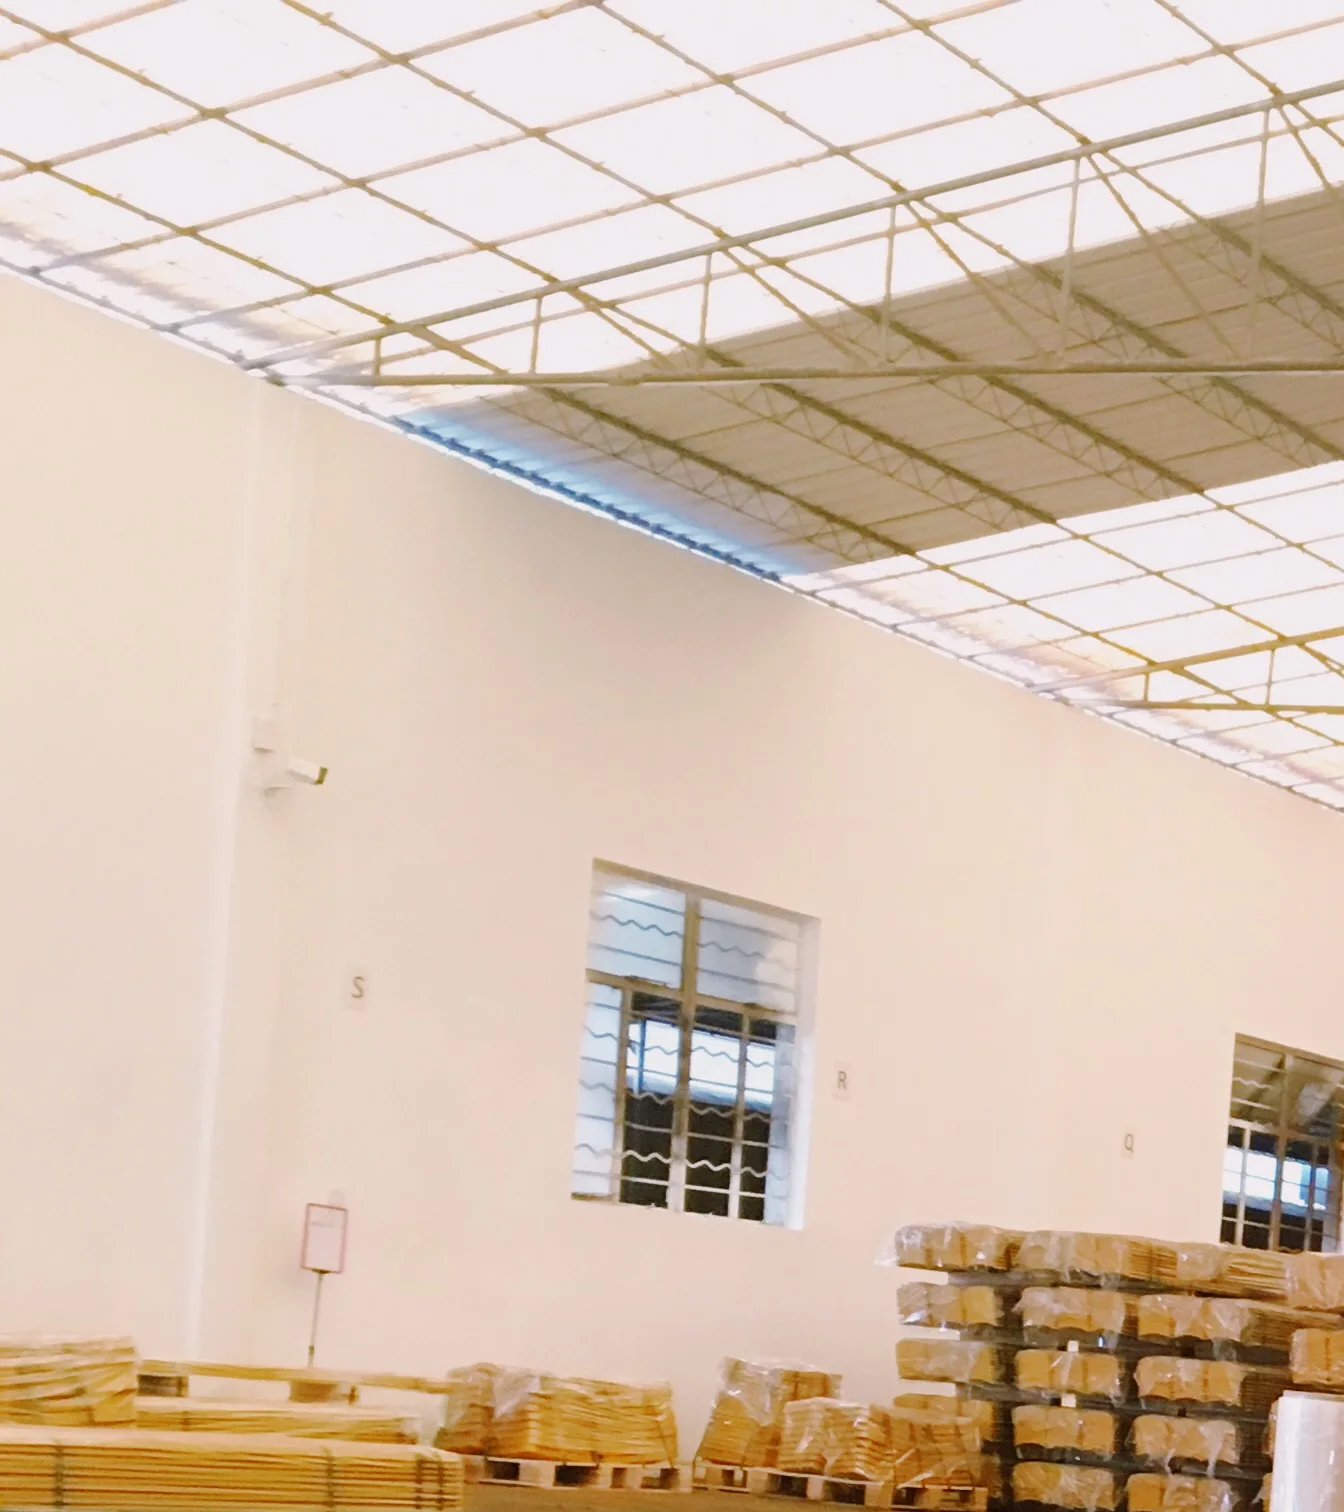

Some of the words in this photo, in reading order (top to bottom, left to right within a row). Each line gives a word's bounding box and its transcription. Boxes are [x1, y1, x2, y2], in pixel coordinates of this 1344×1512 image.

[351, 976, 365, 999] S
[837, 1070, 848, 1090] R
[1124, 1133, 1134, 1153] Q
